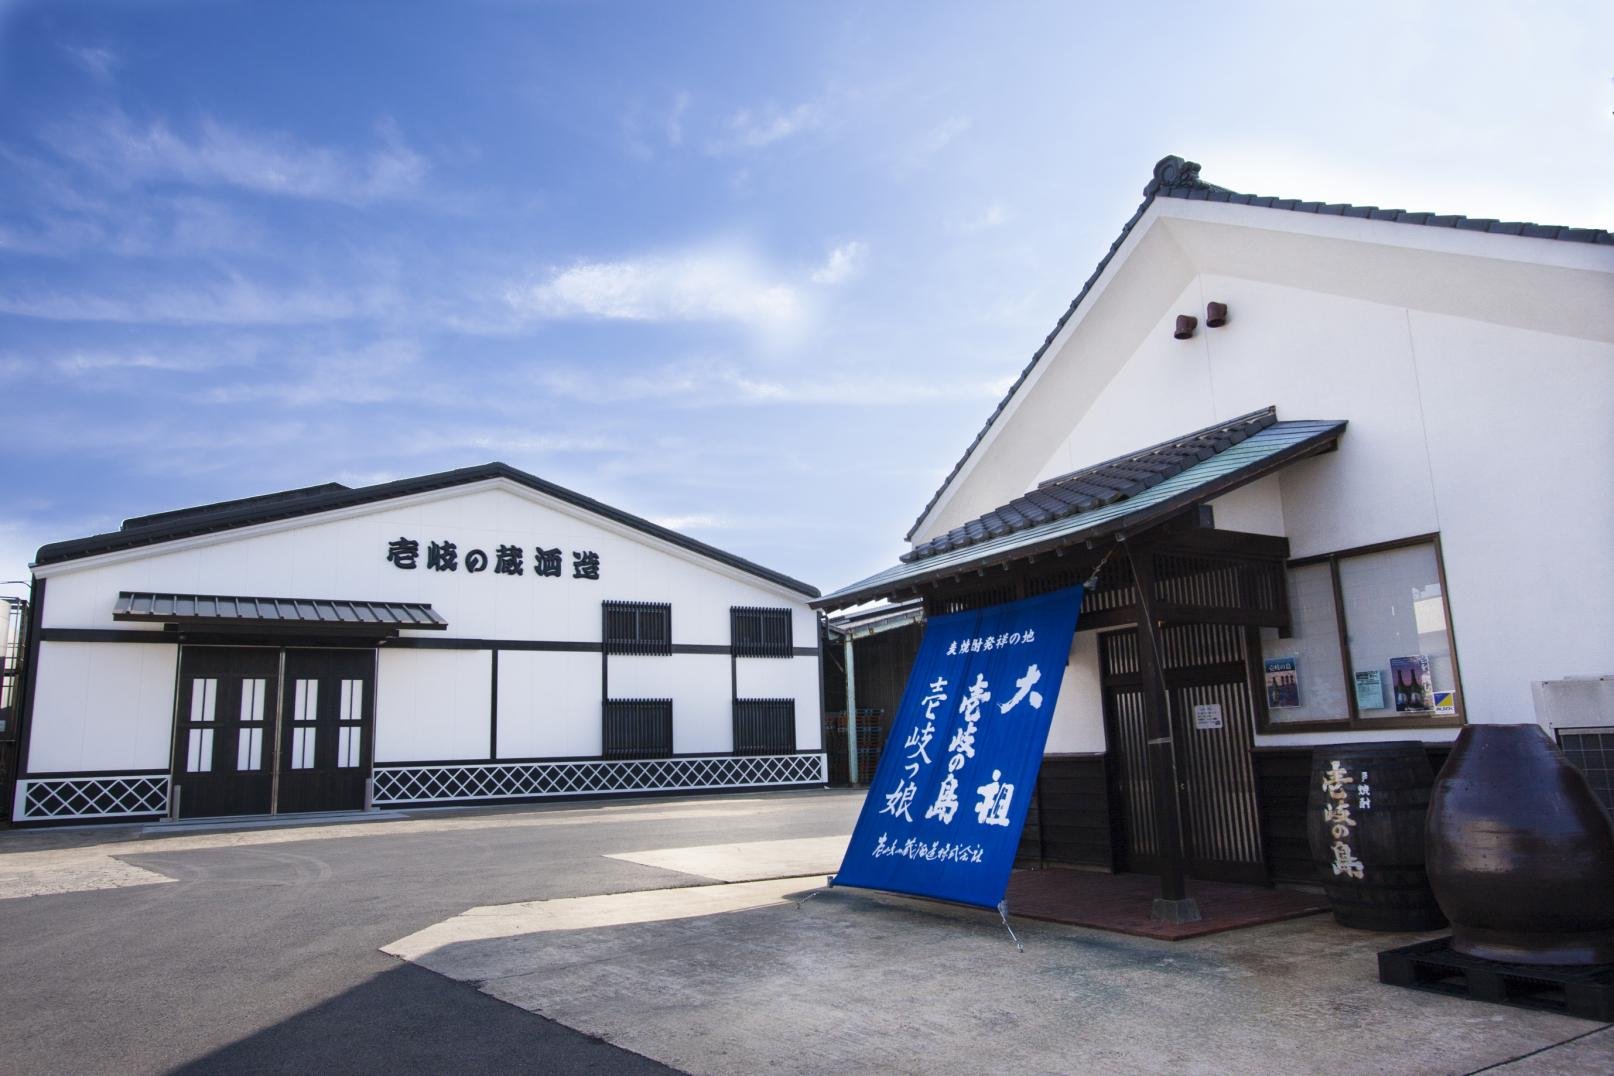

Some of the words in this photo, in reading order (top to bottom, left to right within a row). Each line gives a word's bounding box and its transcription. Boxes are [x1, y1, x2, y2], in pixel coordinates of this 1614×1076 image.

[386, 536, 601, 580] 壱岐の蔵酒造
[946, 628, 1035, 656] 麦焼酎発祥の地
[878, 676, 949, 823] 壱岐っ娘
[925, 672, 992, 825] 壱岐の島
